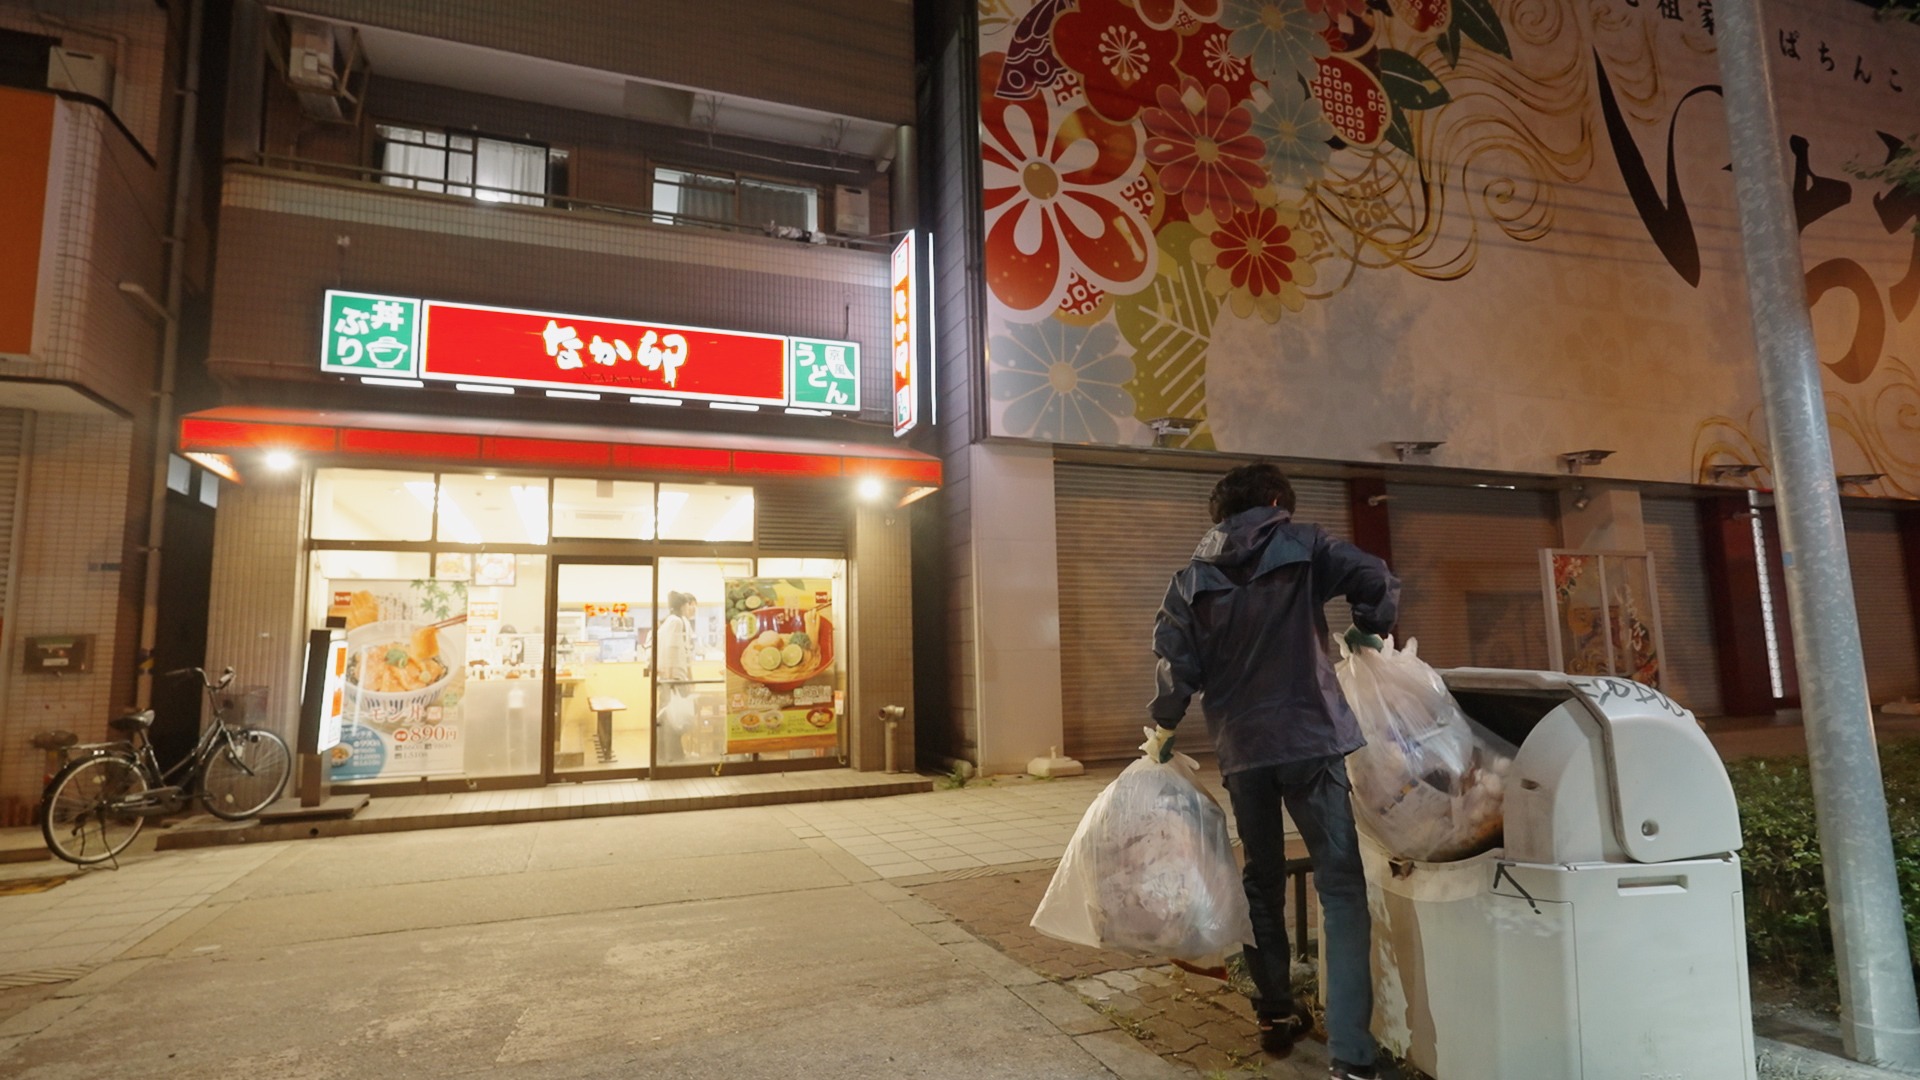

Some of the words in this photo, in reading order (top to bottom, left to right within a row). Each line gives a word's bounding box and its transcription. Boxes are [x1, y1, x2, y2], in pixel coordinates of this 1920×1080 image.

[543, 319, 688, 388] なか卯
[796, 343, 848, 404] うどん
[829, 349, 846, 375] 京風
[582, 371, 648, 386] NAKAU
